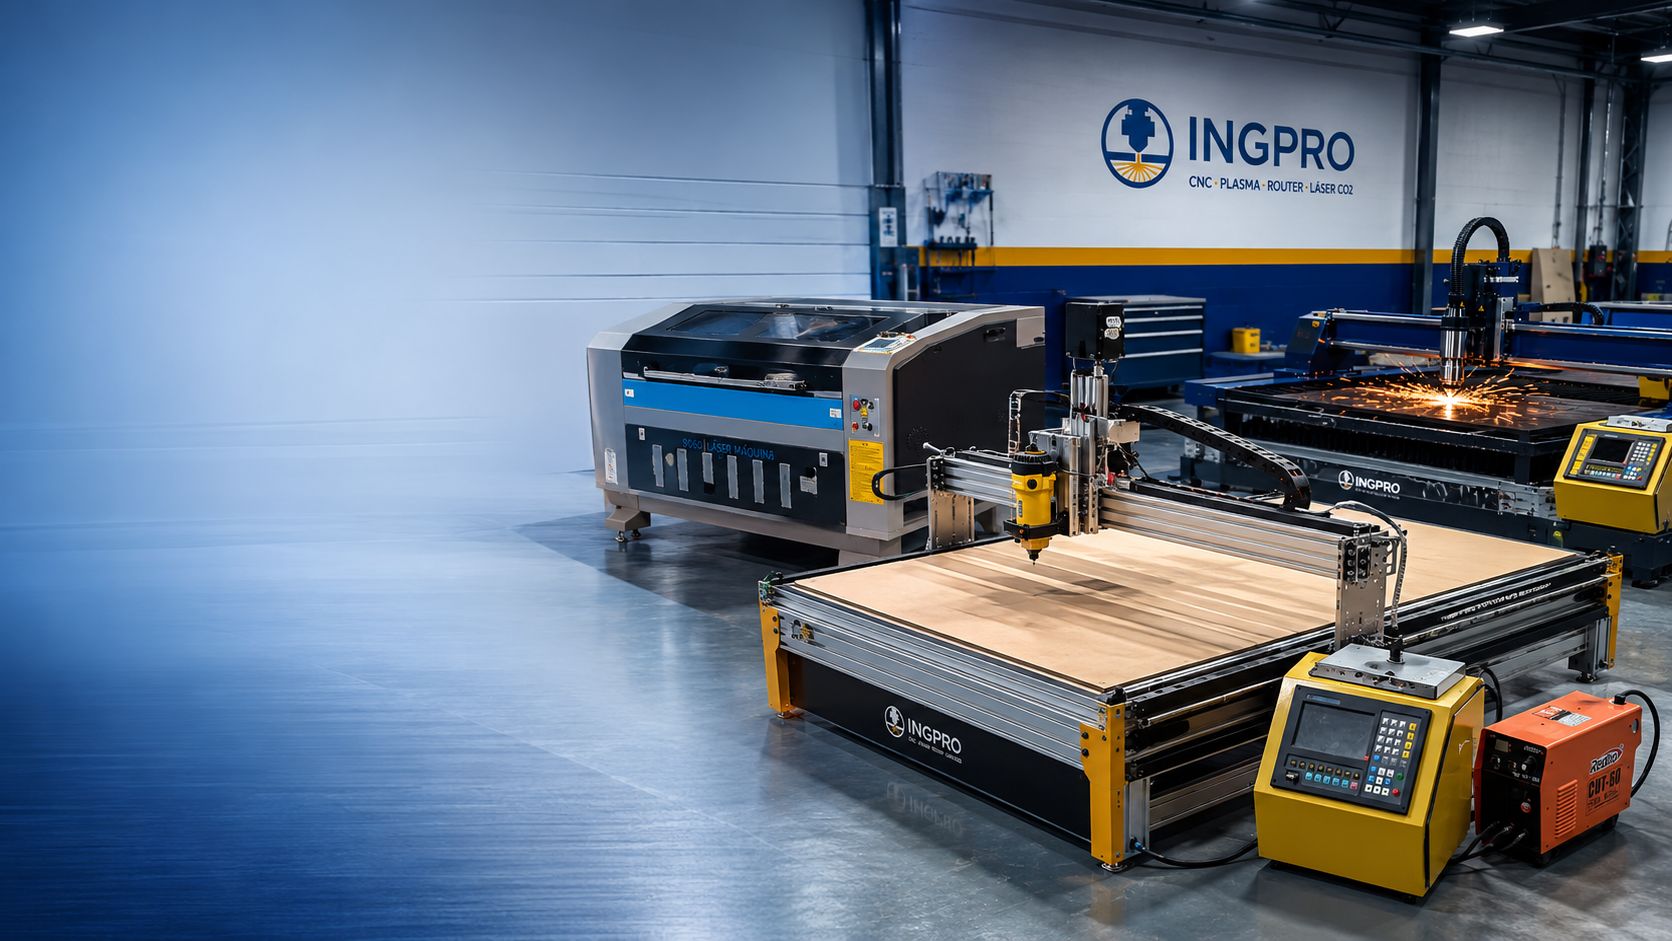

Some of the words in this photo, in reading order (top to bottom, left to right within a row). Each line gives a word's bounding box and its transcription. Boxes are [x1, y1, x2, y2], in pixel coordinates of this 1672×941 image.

[1189, 116, 1355, 171] INGPRO
[1189, 175, 1213, 189] CNC
[1220, 177, 1261, 191] PLASMA
[1267, 179, 1304, 193] ROUTER
[1309, 180, 1336, 195] LÁSER
[1337, 184, 1354, 195] CO2
[1355, 475, 1401, 494] INGPRO
[907, 717, 962, 755] INGPRO
[1588, 767, 1621, 799] CUT-60
